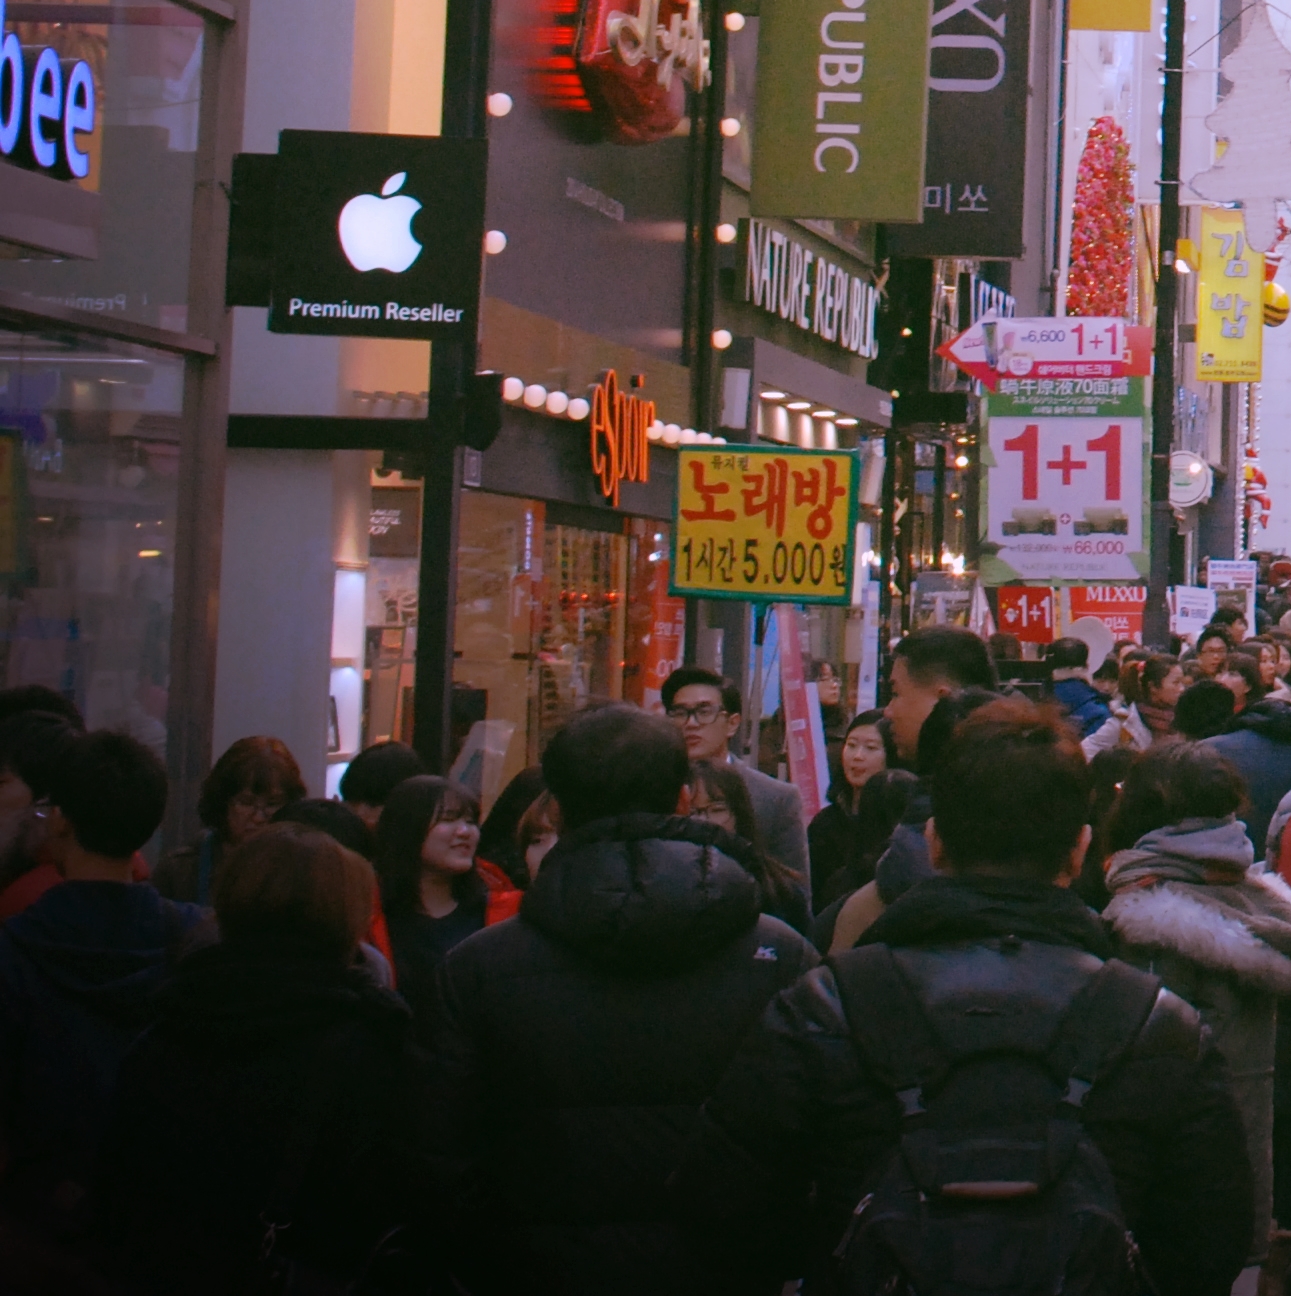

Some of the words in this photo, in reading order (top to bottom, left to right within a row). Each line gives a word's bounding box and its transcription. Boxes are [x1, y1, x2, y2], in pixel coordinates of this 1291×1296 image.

[923, 181, 989, 214] 미쏘
[746, 219, 812, 332] NATURE
[813, 242, 882, 362] REPUBLIC
[1210, 230, 1250, 339] 김밥
[288, 298, 381, 322] Premium
[385, 301, 464, 324] Reseller
[1070, 323, 1119, 356] 1+1
[1003, 424, 1123, 502] 1+1
[680, 457, 847, 541] 노래방
[682, 537, 737, 583] 1시간
[1017, 593, 1052, 628] 1+1
